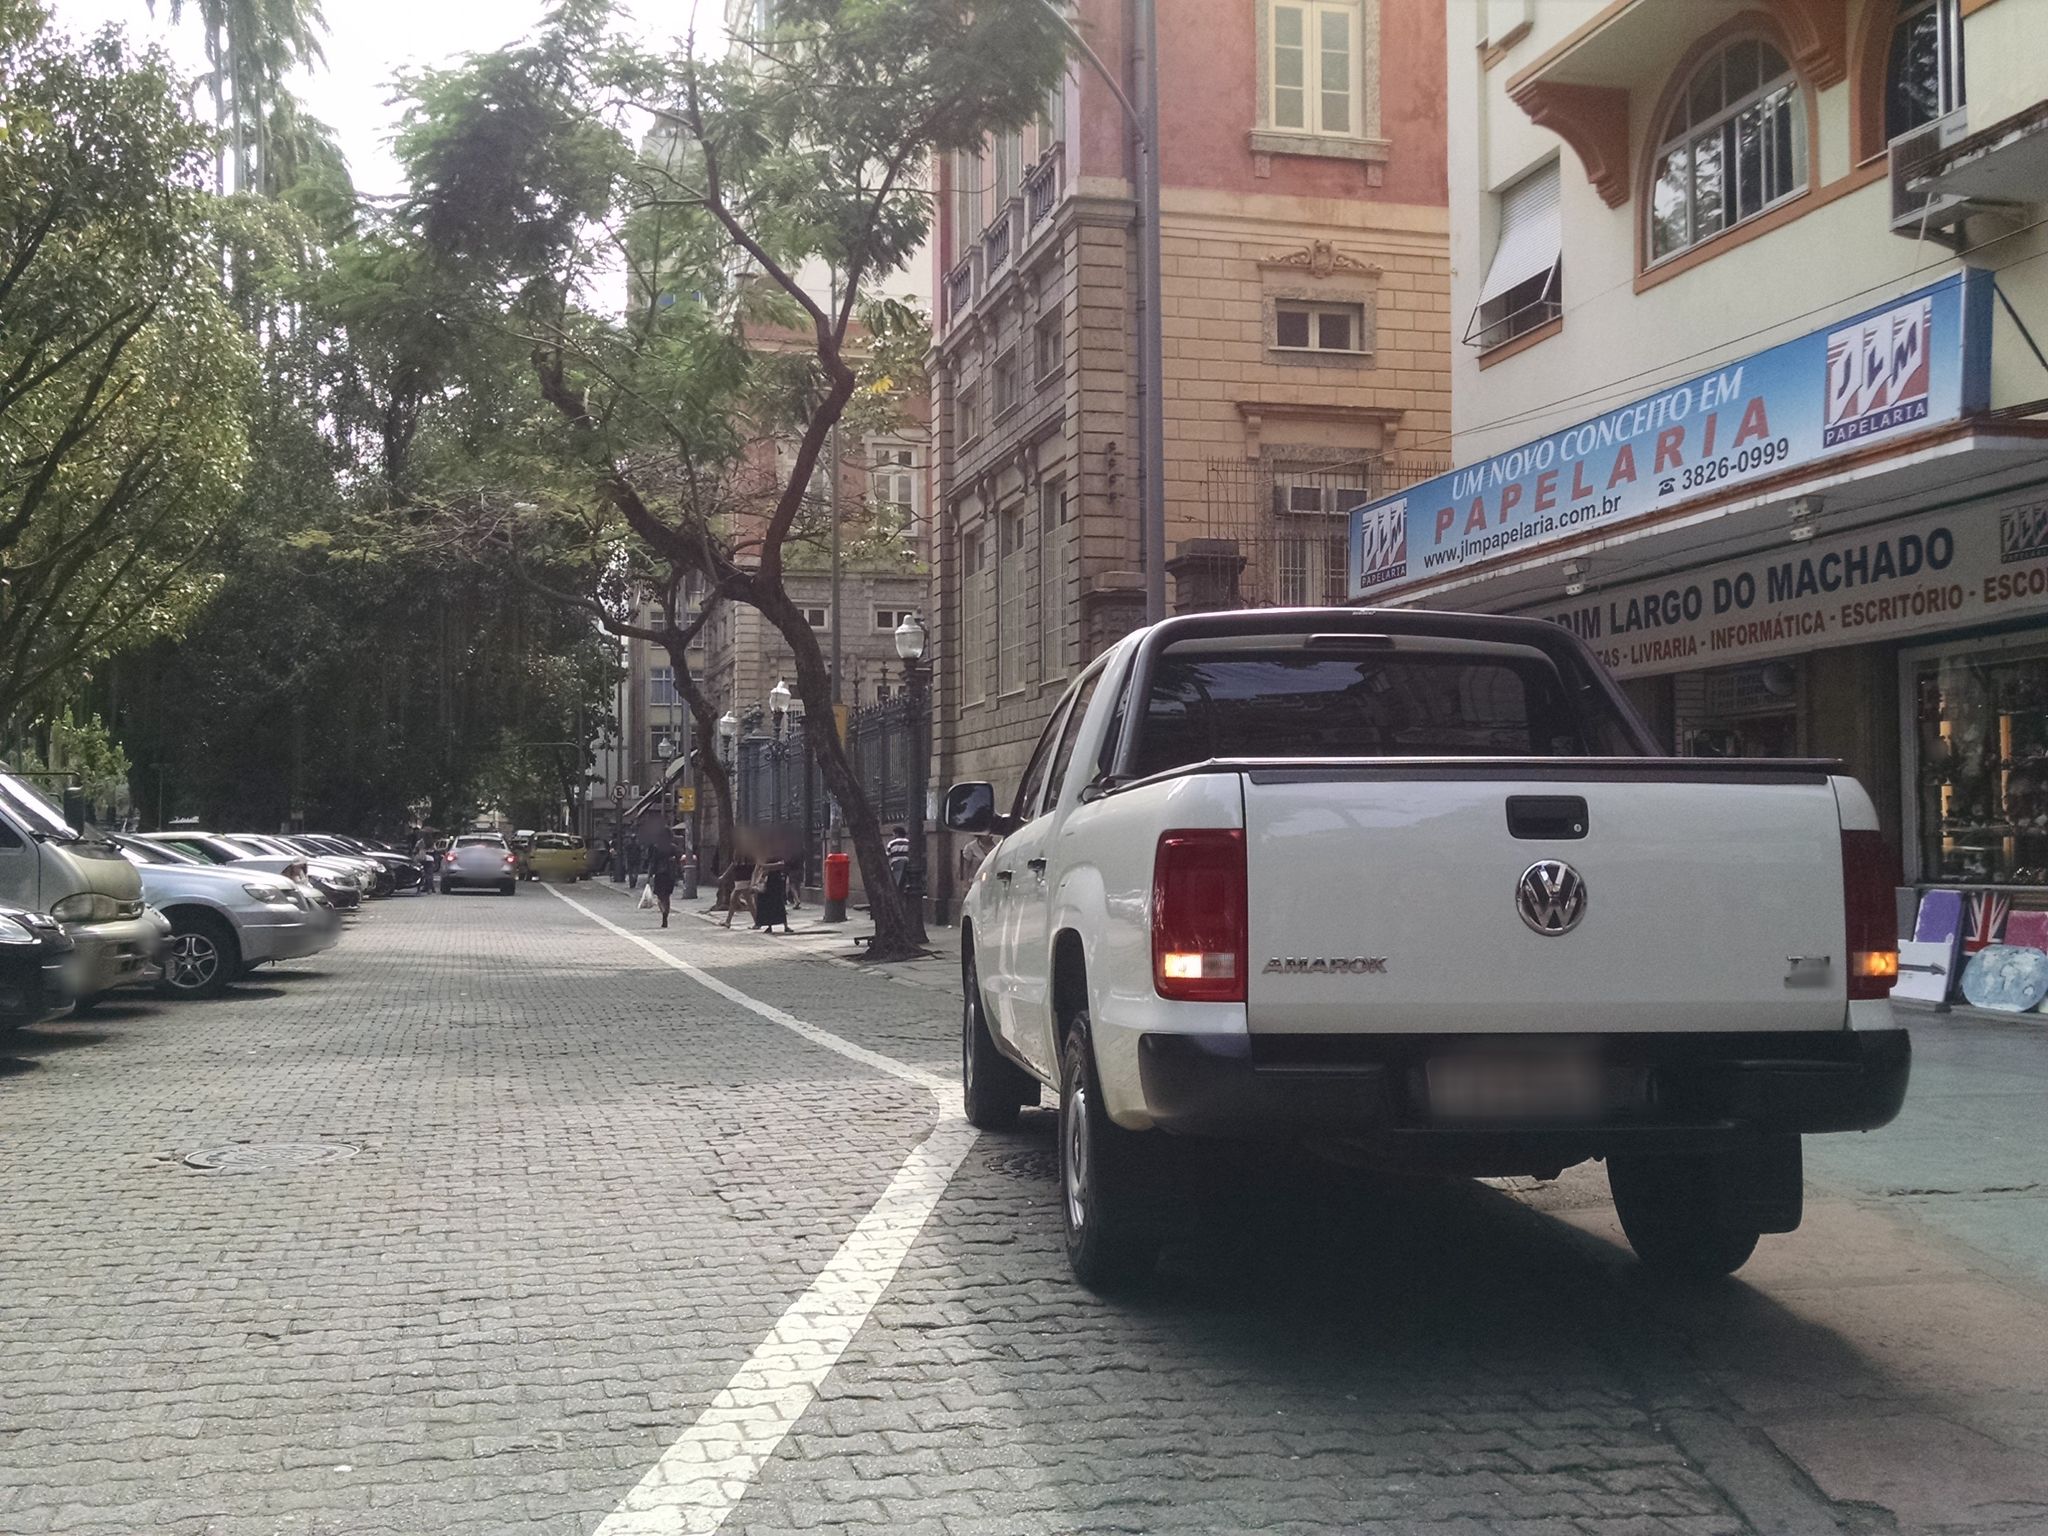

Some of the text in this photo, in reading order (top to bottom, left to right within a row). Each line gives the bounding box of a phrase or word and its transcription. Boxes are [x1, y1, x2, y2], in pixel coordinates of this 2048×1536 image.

[1452, 366, 1744, 500] UM NOVO CONCEITO EM
[1826, 402, 1926, 445] PAPELARIA
[1434, 395, 1770, 545] PAPELARIA
[1682, 437, 1790, 491] 3826-0999
[1424, 495, 1622, 569] www.jlmpapelaria.com.br
[1361, 566, 1406, 588] PAPELARIA
[1610, 585, 1703, 635] LARGO
[1713, 572, 1756, 615] DO
[1767, 527, 1955, 604] MACHADO
[1631, 635, 1698, 665] LIVRARIA
[1711, 609, 1825, 651] INFORMÁTICA
[1841, 583, 1964, 628] ESCRITÓRIO
[1984, 566, 2048, 604] ESCO
[1261, 956, 1388, 975] AMAROK
